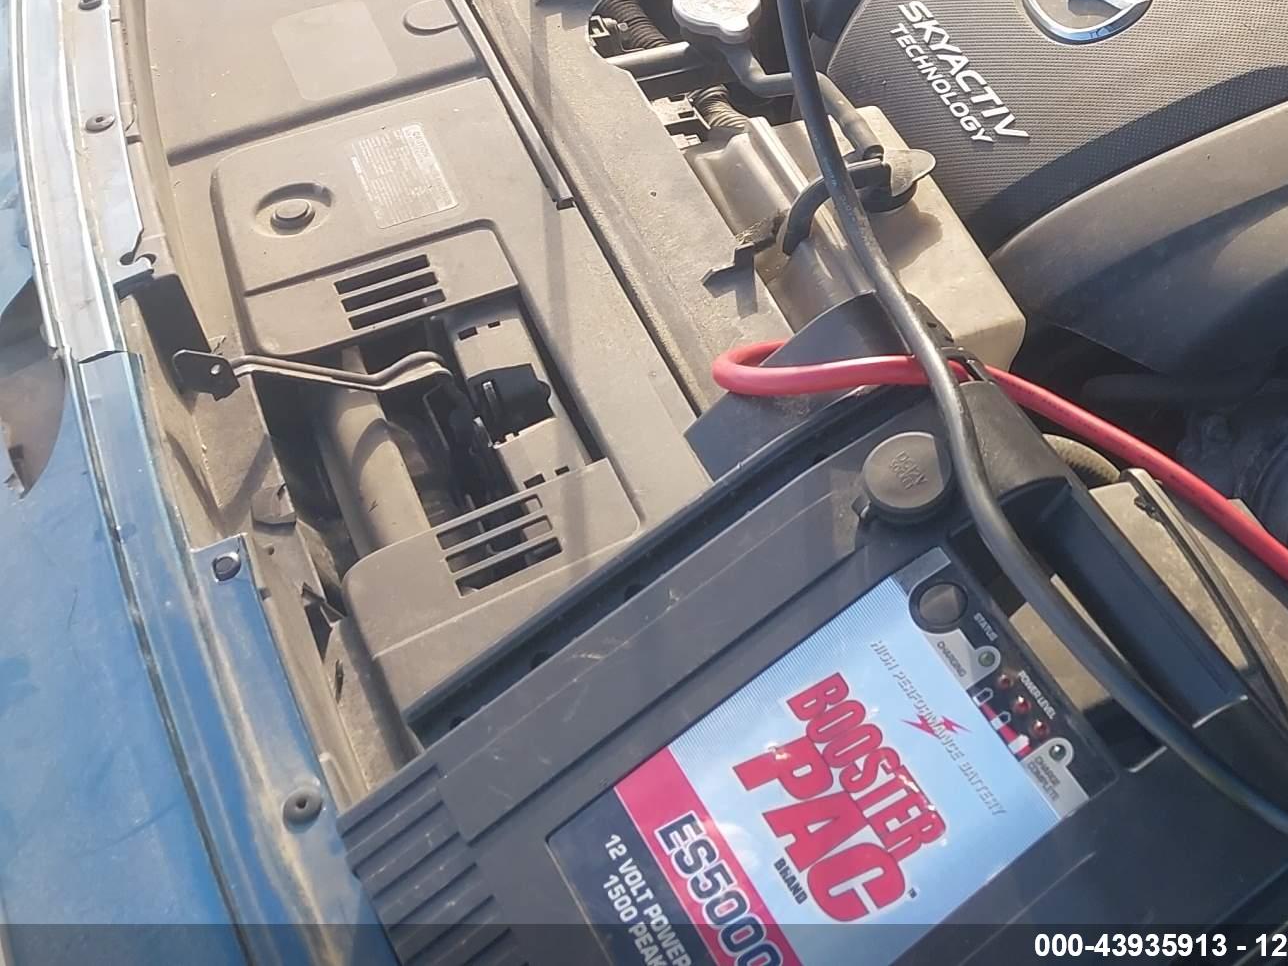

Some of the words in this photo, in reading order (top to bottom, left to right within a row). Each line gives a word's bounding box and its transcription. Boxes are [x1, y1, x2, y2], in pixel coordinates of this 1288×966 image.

[890, 23, 994, 143] TECHNOLOGY
[898, 0, 1031, 138] SKYACTIV
[937, 640, 967, 678] CHARGING
[973, 612, 998, 641] STATUS
[870, 640, 897, 672] HIGH
[894, 669, 964, 761] PERFORMANCE
[959, 759, 1007, 816] BATTERY
[1017, 669, 1042, 702] POWER
[1037, 696, 1057, 721] LEVEL
[786, 672, 946, 861] BOOSTER
[604, 834, 628, 860] 12
[618, 858, 654, 904] VOLT
[732, 737, 906, 922] PAC
[603, 874, 638, 923] 1500
[654, 810, 783, 966] ES5000
[773, 858, 808, 905] BRAND
